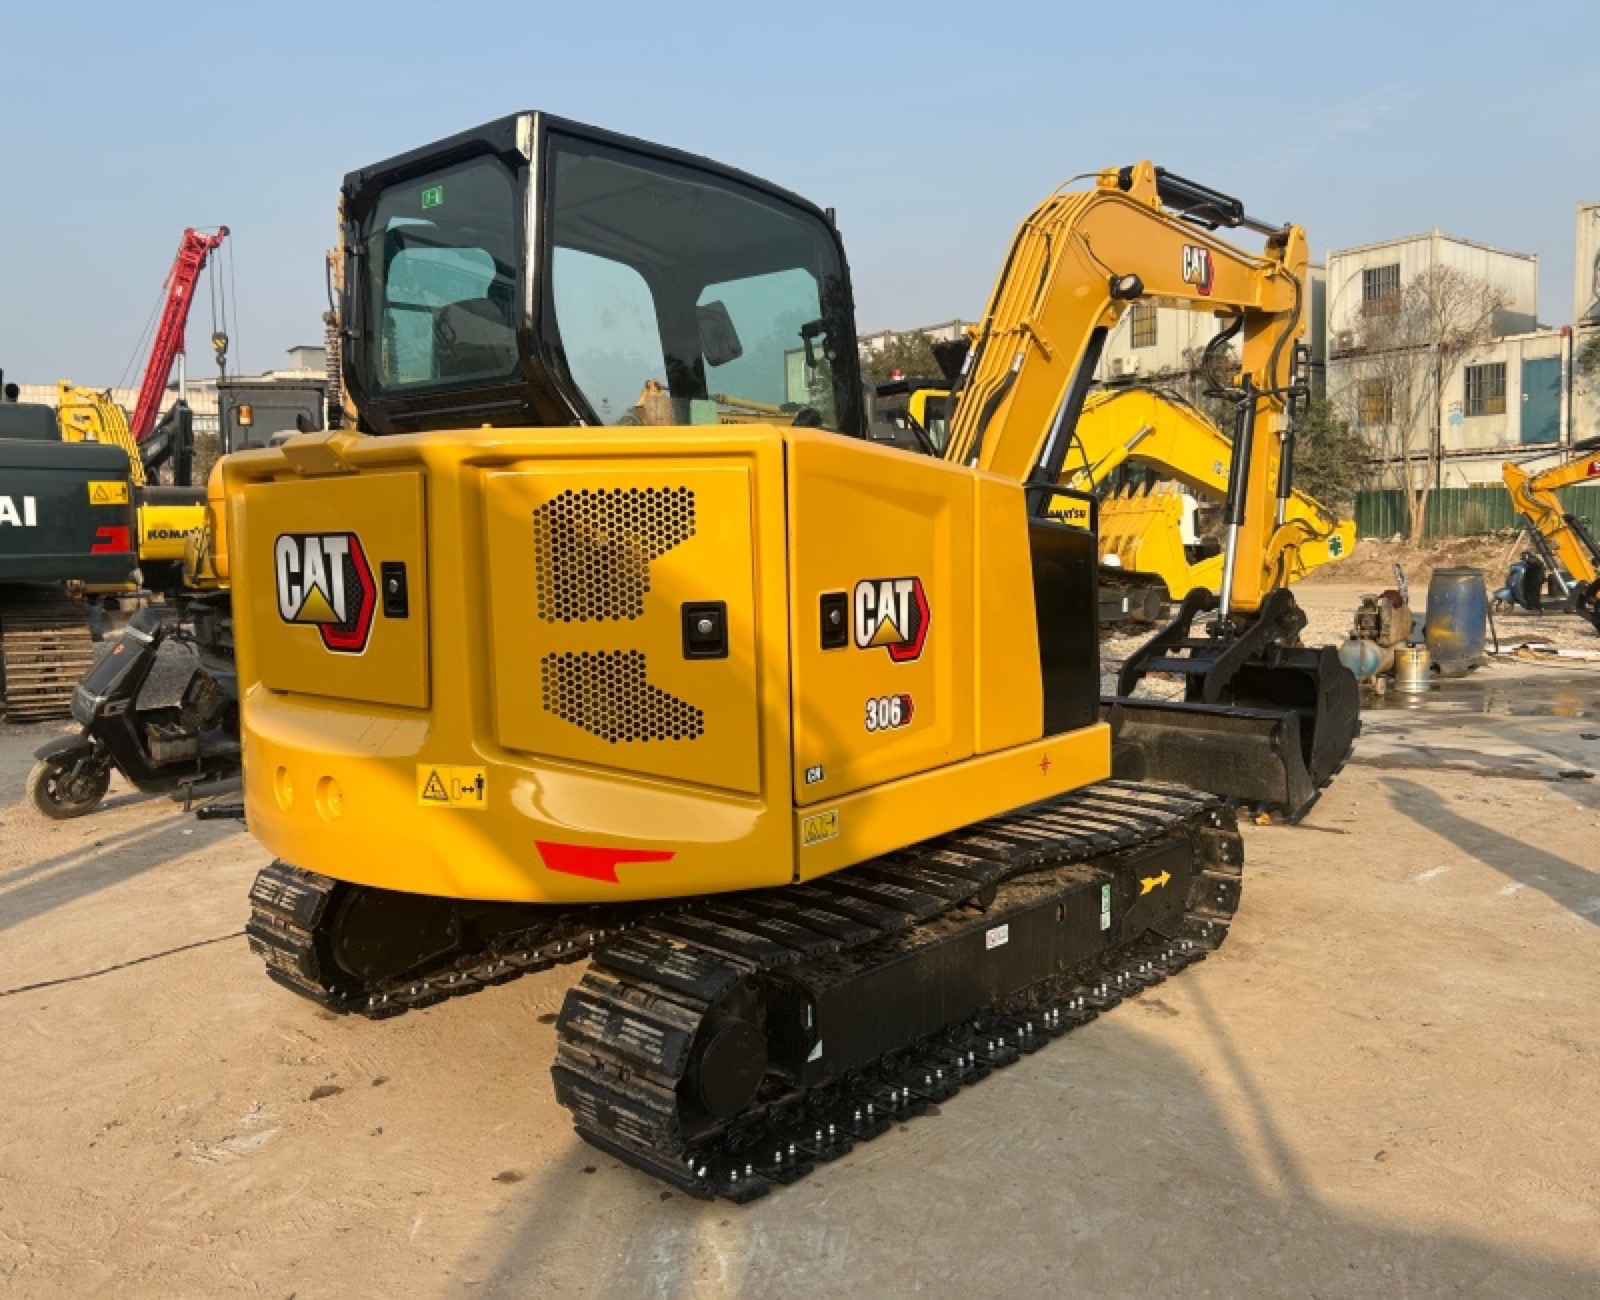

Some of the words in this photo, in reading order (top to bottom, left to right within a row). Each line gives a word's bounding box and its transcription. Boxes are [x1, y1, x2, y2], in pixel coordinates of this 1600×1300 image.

[1183, 245, 1207, 283] CAT
[276, 535, 349, 622] CAT
[855, 579, 913, 647] CAT
[866, 697, 901, 730] 306
